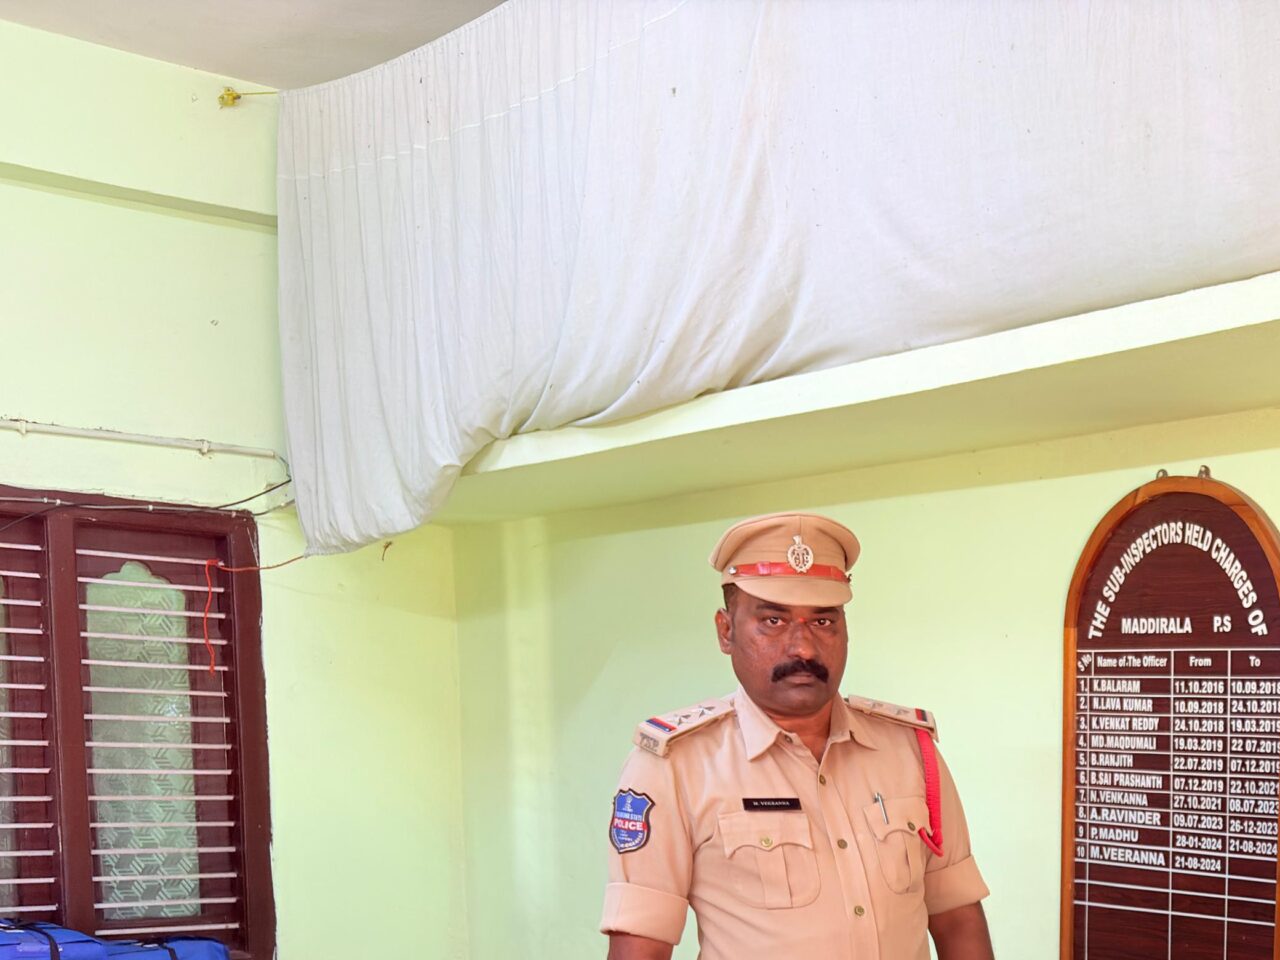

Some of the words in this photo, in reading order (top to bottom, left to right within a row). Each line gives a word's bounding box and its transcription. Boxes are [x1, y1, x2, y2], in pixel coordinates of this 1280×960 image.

[1088, 601, 1111, 640] THE
[1102, 521, 1183, 602] SUB-INSPECTORS
[1185, 522, 1212, 552] HELD
[1211, 538, 1258, 609] CHARGES
[1247, 609, 1268, 637] OF
[1121, 617, 1192, 634] MADDIRALA
[1213, 616, 1232, 633] P.S
[1097, 656, 1117, 667] Name
[1143, 656, 1167, 667] Officer
[1189, 656, 1212, 667] From
[1249, 655, 1261, 667] To
[1093, 679, 1140, 693] K.BALARAM
[1175, 681, 1224, 694] 11.10.2016
[1123, 698, 1153, 712] KUMAR
[1175, 701, 1224, 714] 10.09.2018
[1092, 716, 1130, 730] K.VENKAT
[1132, 717, 1159, 731] REDDY
[1174, 719, 1224, 732] 24.10.2018
[1174, 738, 1223, 752] 19.03.2019
[1091, 753, 1133, 767] B.RANJITH
[1173, 757, 1223, 771] 22.07.2019
[1114, 773, 1162, 789] PRASHANTH
[1174, 778, 1224, 792] 07.12.2019
[1090, 790, 1148, 807] N.VENKANNA
[1173, 796, 1222, 810] 27.10.2021
[1090, 808, 1161, 826] A.RAVINDER
[1173, 814, 1223, 830] 09.07.2023
[1090, 827, 1139, 842] P.MADHU
[1090, 845, 1165, 866] M.VEERANNA
